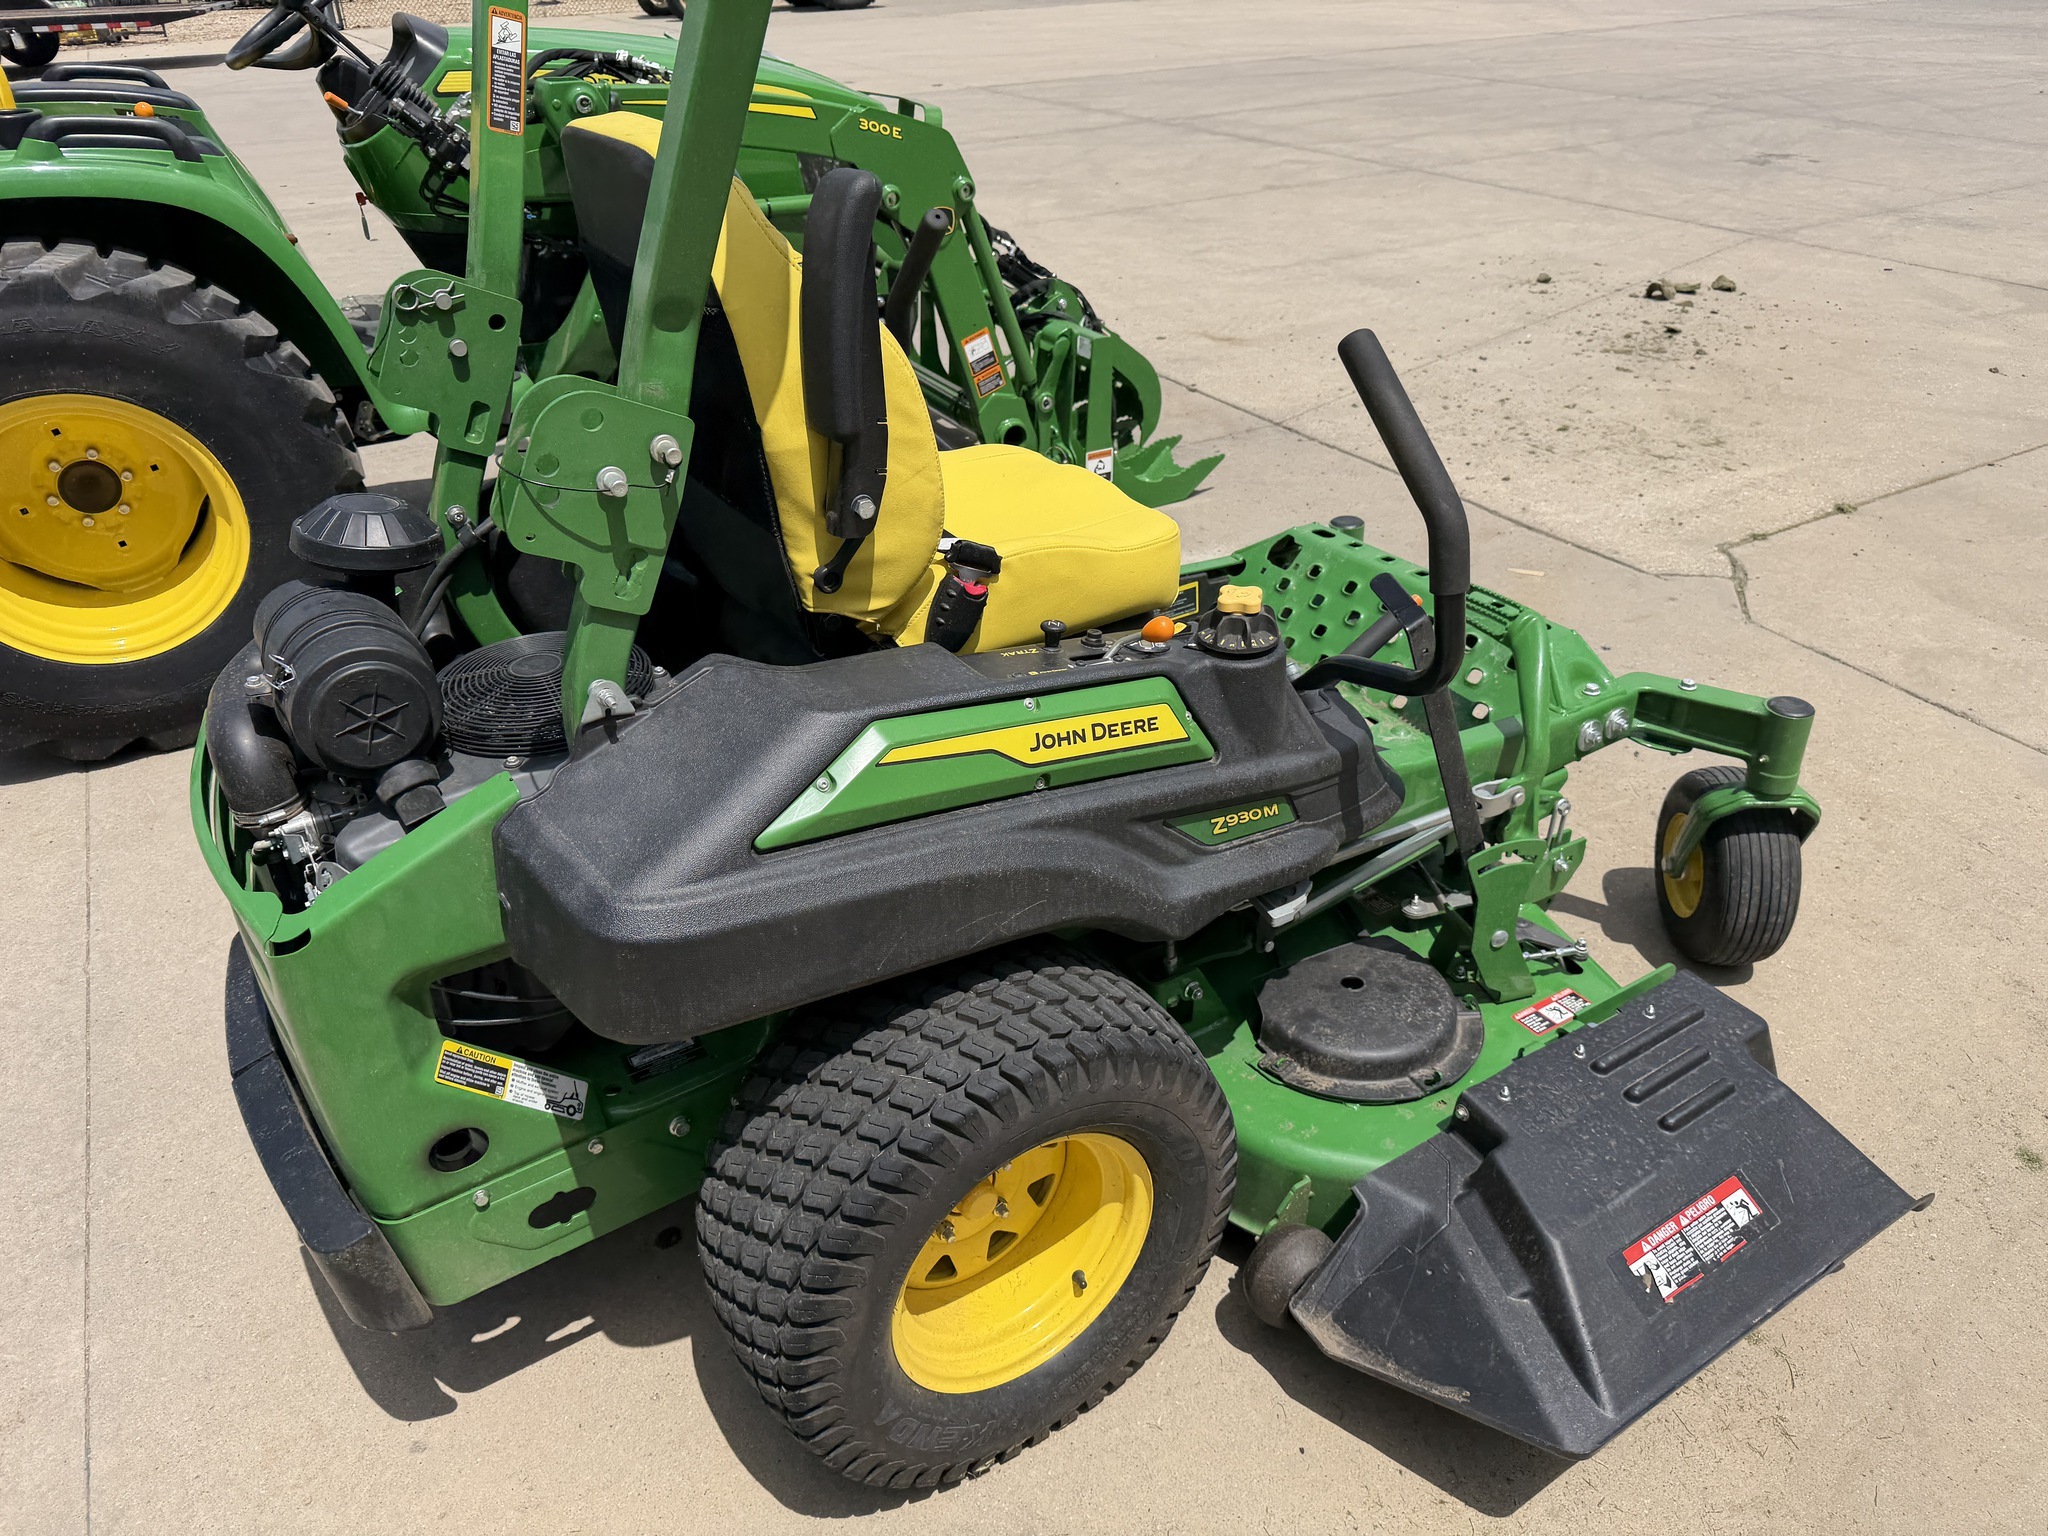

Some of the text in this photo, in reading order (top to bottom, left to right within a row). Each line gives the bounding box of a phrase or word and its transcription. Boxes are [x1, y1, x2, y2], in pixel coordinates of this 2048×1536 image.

[1000, 648, 1040, 658] ZTRAK
[1030, 716, 1159, 752] JOHN DEERE
[464, 1049, 497, 1064] CAUTION
[1647, 1221, 1679, 1247] DANGER
[1684, 1194, 1716, 1220] PELIGRO
